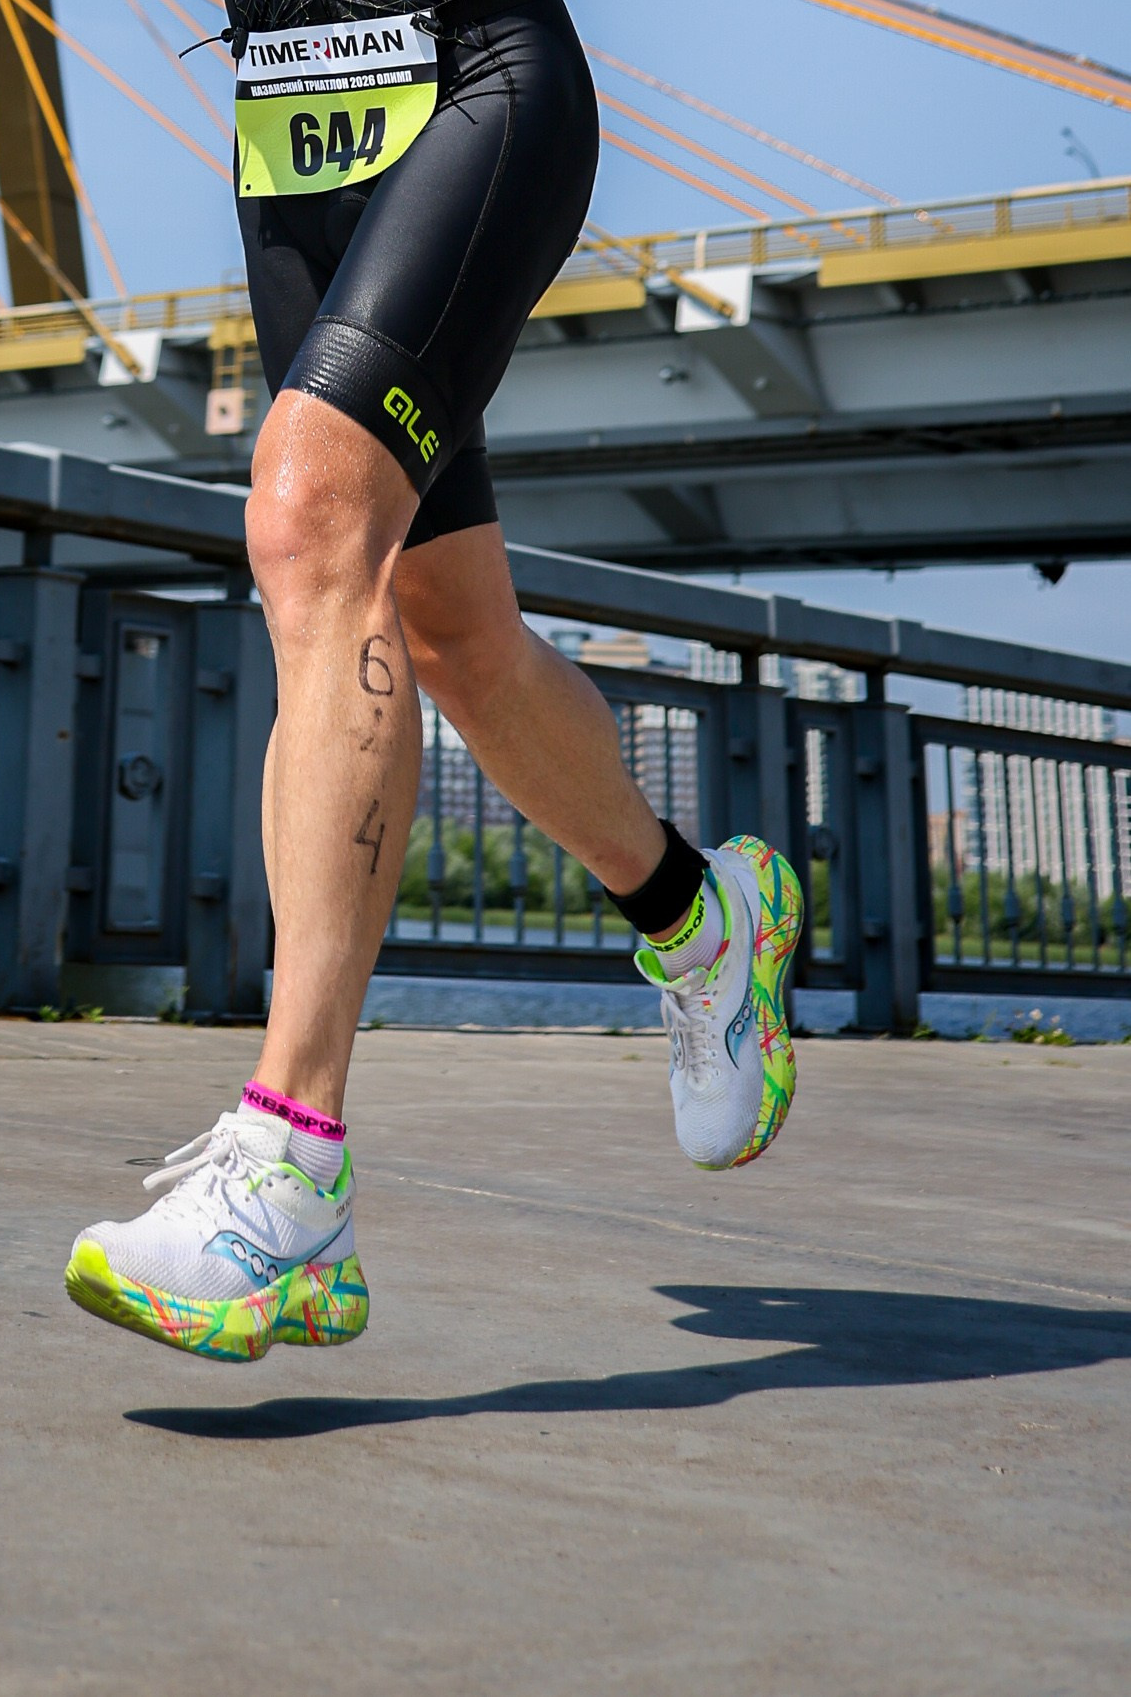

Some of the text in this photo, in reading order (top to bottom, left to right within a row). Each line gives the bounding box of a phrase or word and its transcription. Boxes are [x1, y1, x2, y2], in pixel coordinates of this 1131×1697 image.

[248, 29, 405, 67] TIMERMAN
[250, 70, 413, 97] КАЗАНСКИЙ ТРИАТЛОН 2026 ОЛИМП
[289, 107, 387, 177] 644
